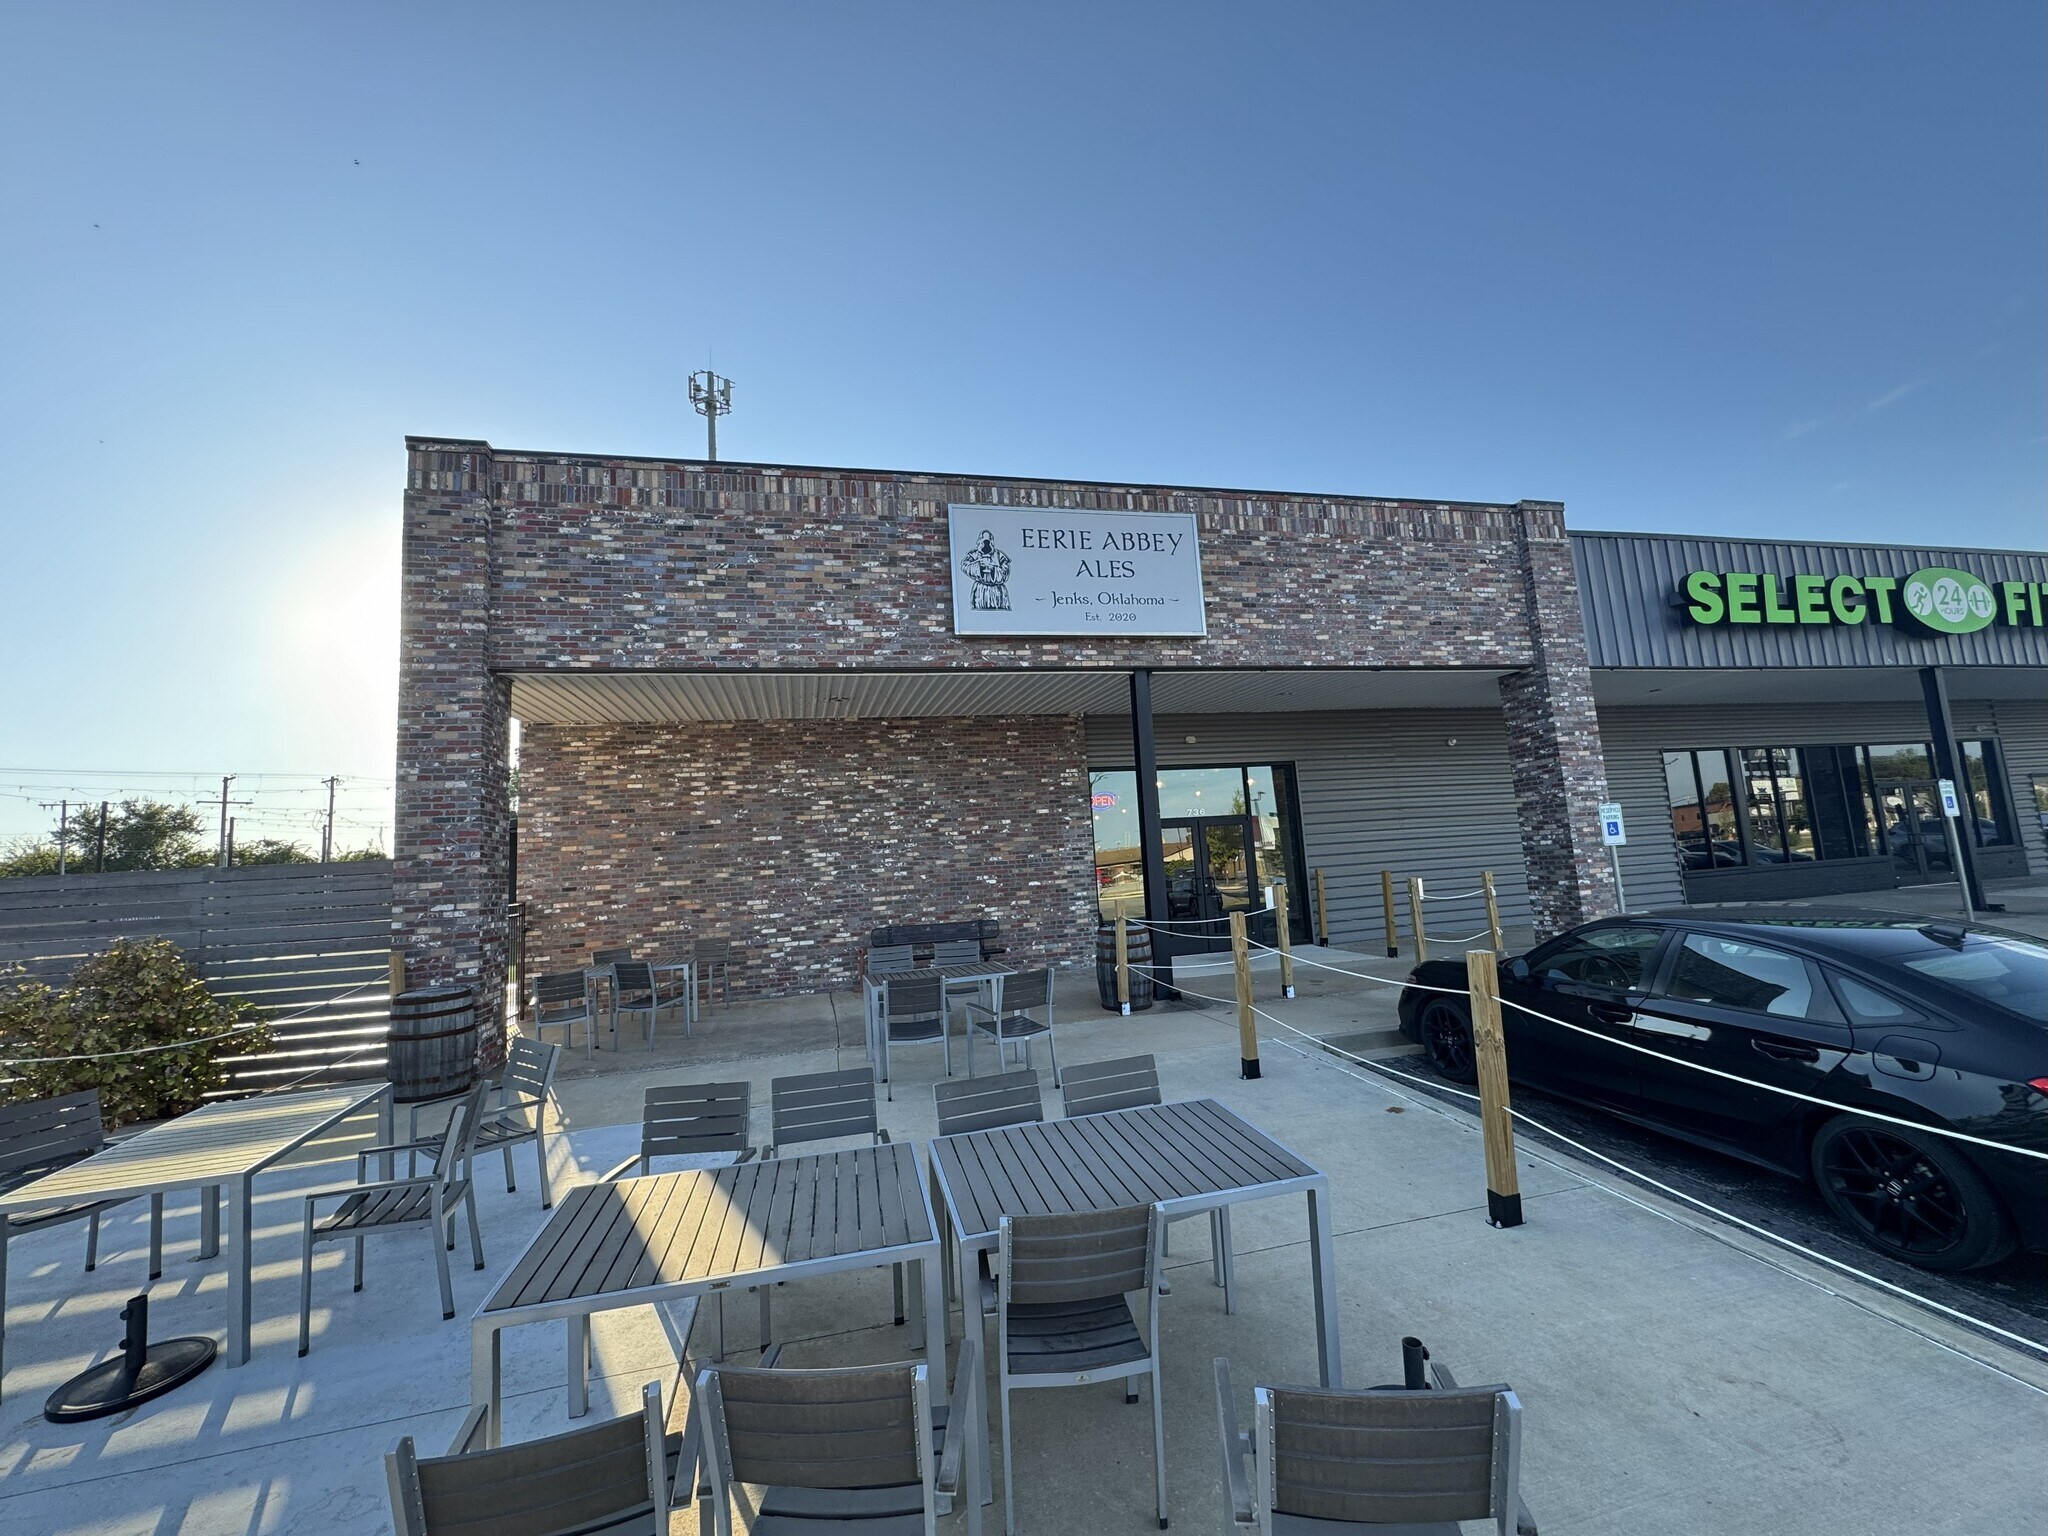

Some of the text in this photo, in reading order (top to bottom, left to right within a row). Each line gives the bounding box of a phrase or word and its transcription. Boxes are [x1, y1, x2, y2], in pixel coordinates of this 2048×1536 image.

[1021, 528, 1183, 555] EERIE ABBEY
[1075, 559, 1136, 578] ALES
[1051, 590, 1165, 609] Jenks, Oklahoma
[1687, 570, 2048, 627] SELECT FI
[1937, 584, 1962, 606] 24
[1085, 612, 1137, 622] Est. 2020
[1940, 607, 1965, 616] HOURS
[1186, 808, 1206, 816] 736
